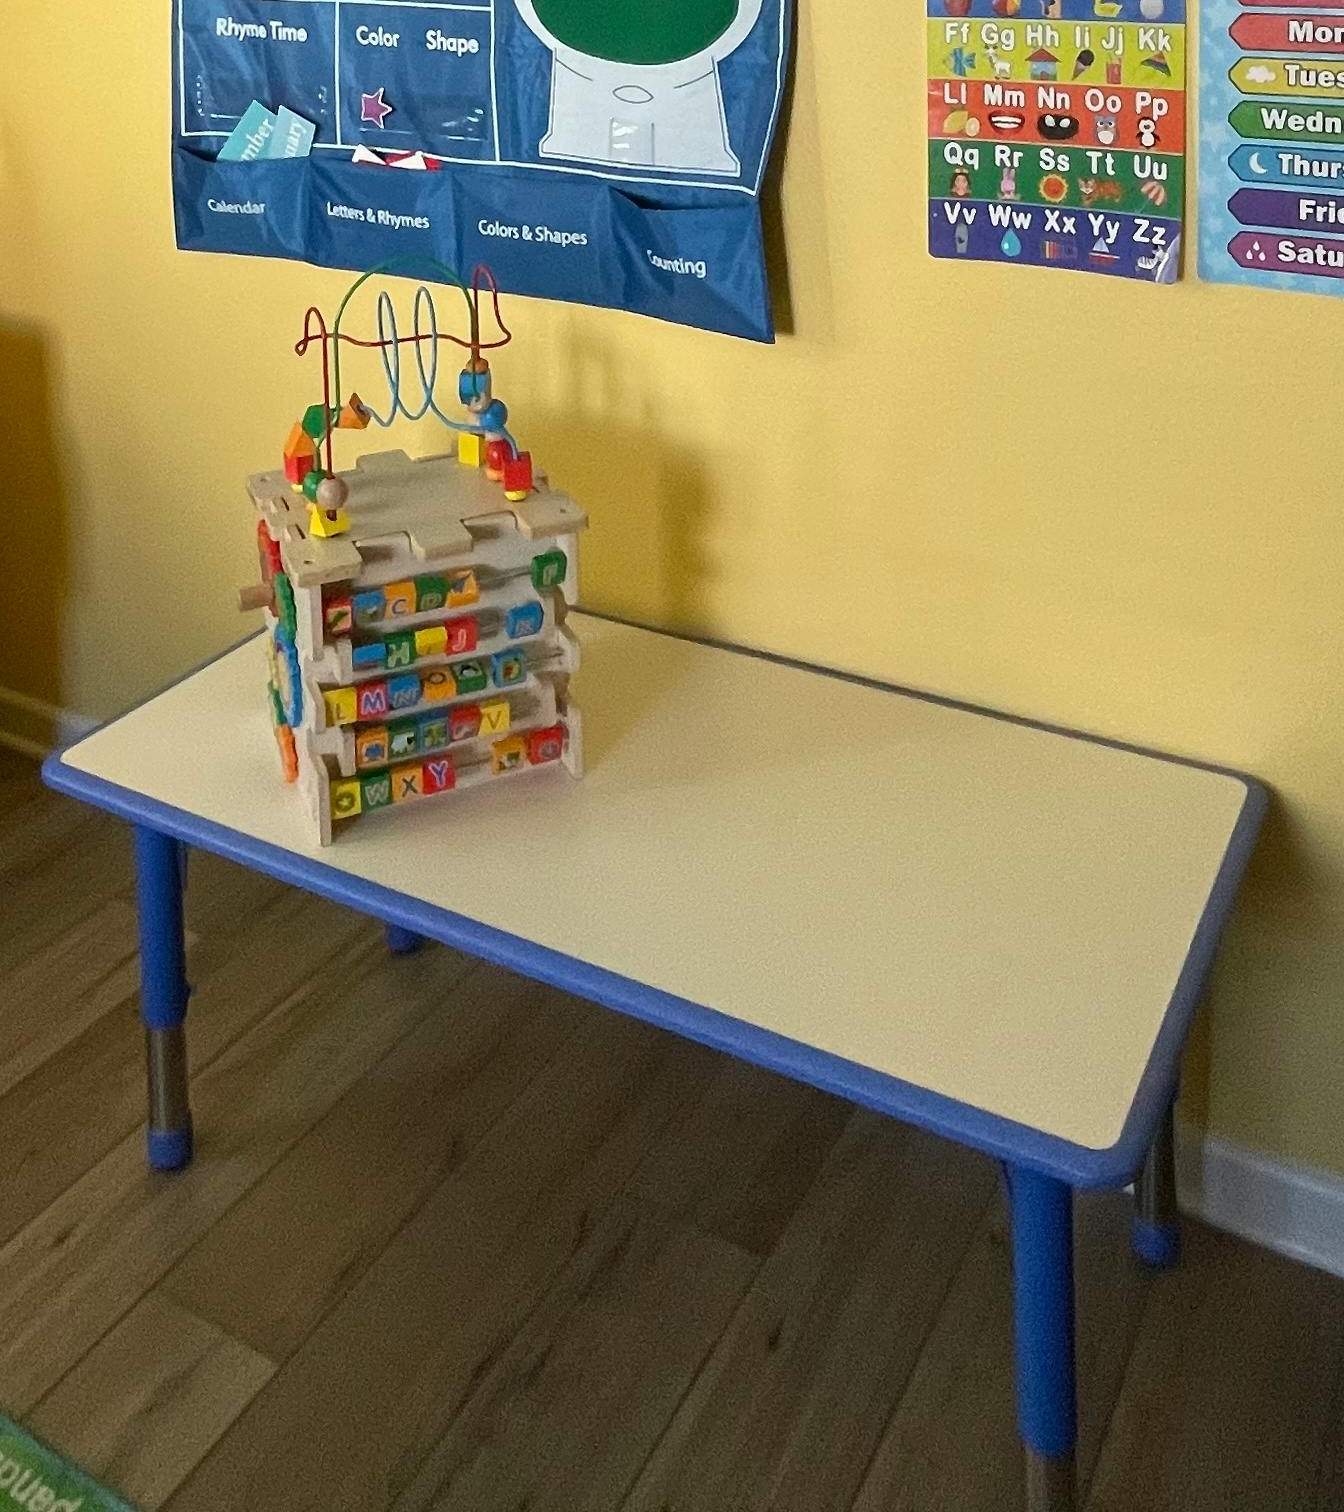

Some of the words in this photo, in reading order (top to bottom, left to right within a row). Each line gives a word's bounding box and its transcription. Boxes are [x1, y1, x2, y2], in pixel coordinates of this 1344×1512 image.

[216, 17, 268, 42] Rhyme
[269, 19, 308, 43] Time
[355, 25, 401, 48] Color
[425, 29, 480, 57] Shape
[945, 22, 970, 45] Ff
[981, 23, 1016, 52] Gg
[1025, 24, 1060, 48] Hh
[1075, 26, 1091, 49] Ii
[1101, 26, 1124, 55] Jj
[1138, 27, 1172, 52] Kk
[943, 82, 967, 106] Ll
[983, 84, 1026, 108] Mm
[1037, 86, 1070, 110] Nn
[1084, 88, 1123, 114] Oo
[1134, 91, 1169, 120] Pp
[943, 141, 980, 172] Qq
[994, 147, 1024, 168] Rr
[1039, 146, 1071, 173] Ss
[1086, 150, 1116, 176] Tt
[1133, 153, 1168, 182] Uu
[207, 198, 266, 215] Calendar
[326, 201, 365, 221] Letters
[366, 207, 376, 224] &
[377, 209, 430, 231] Rhymes
[477, 219, 519, 239] Colors
[521, 225, 533, 241] &
[535, 225, 588, 248] Shapes
[943, 201, 977, 226] Vv
[988, 203, 1032, 230] Ww
[1043, 208, 1077, 235] Xx
[1087, 212, 1121, 245] Yy
[1132, 216, 1167, 247] Zz
[391, 599, 407, 616] C
[452, 628, 467, 652] J
[360, 692, 386, 715] M
[486, 710, 503, 730] V
[364, 781, 389, 805] W
[401, 774, 419, 798] X
[428, 760, 449, 788] Y
